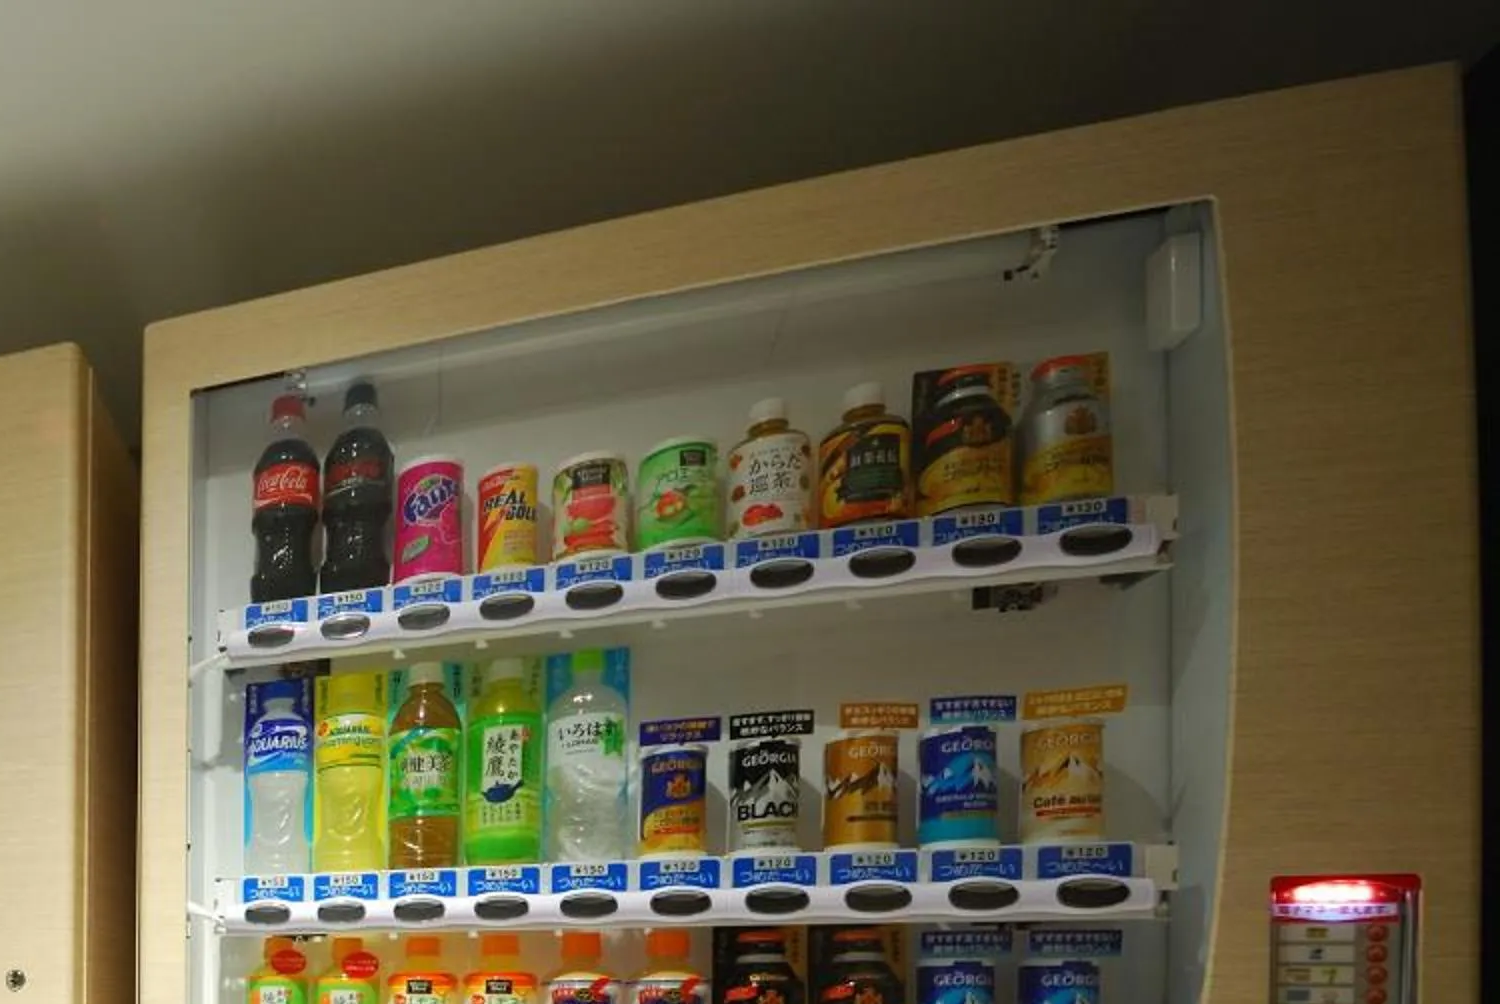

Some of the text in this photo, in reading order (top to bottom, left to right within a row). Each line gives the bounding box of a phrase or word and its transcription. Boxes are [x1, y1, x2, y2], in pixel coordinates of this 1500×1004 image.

[403, 477, 460, 524] Fant
[484, 487, 526, 513] REAL
[250, 732, 309, 754] AQUARIUS
[486, 733, 505, 778] 綾鷹
[758, 857, 792, 869] ¥120
[856, 853, 893, 865] ¥120
[958, 850, 997, 862] ¥120
